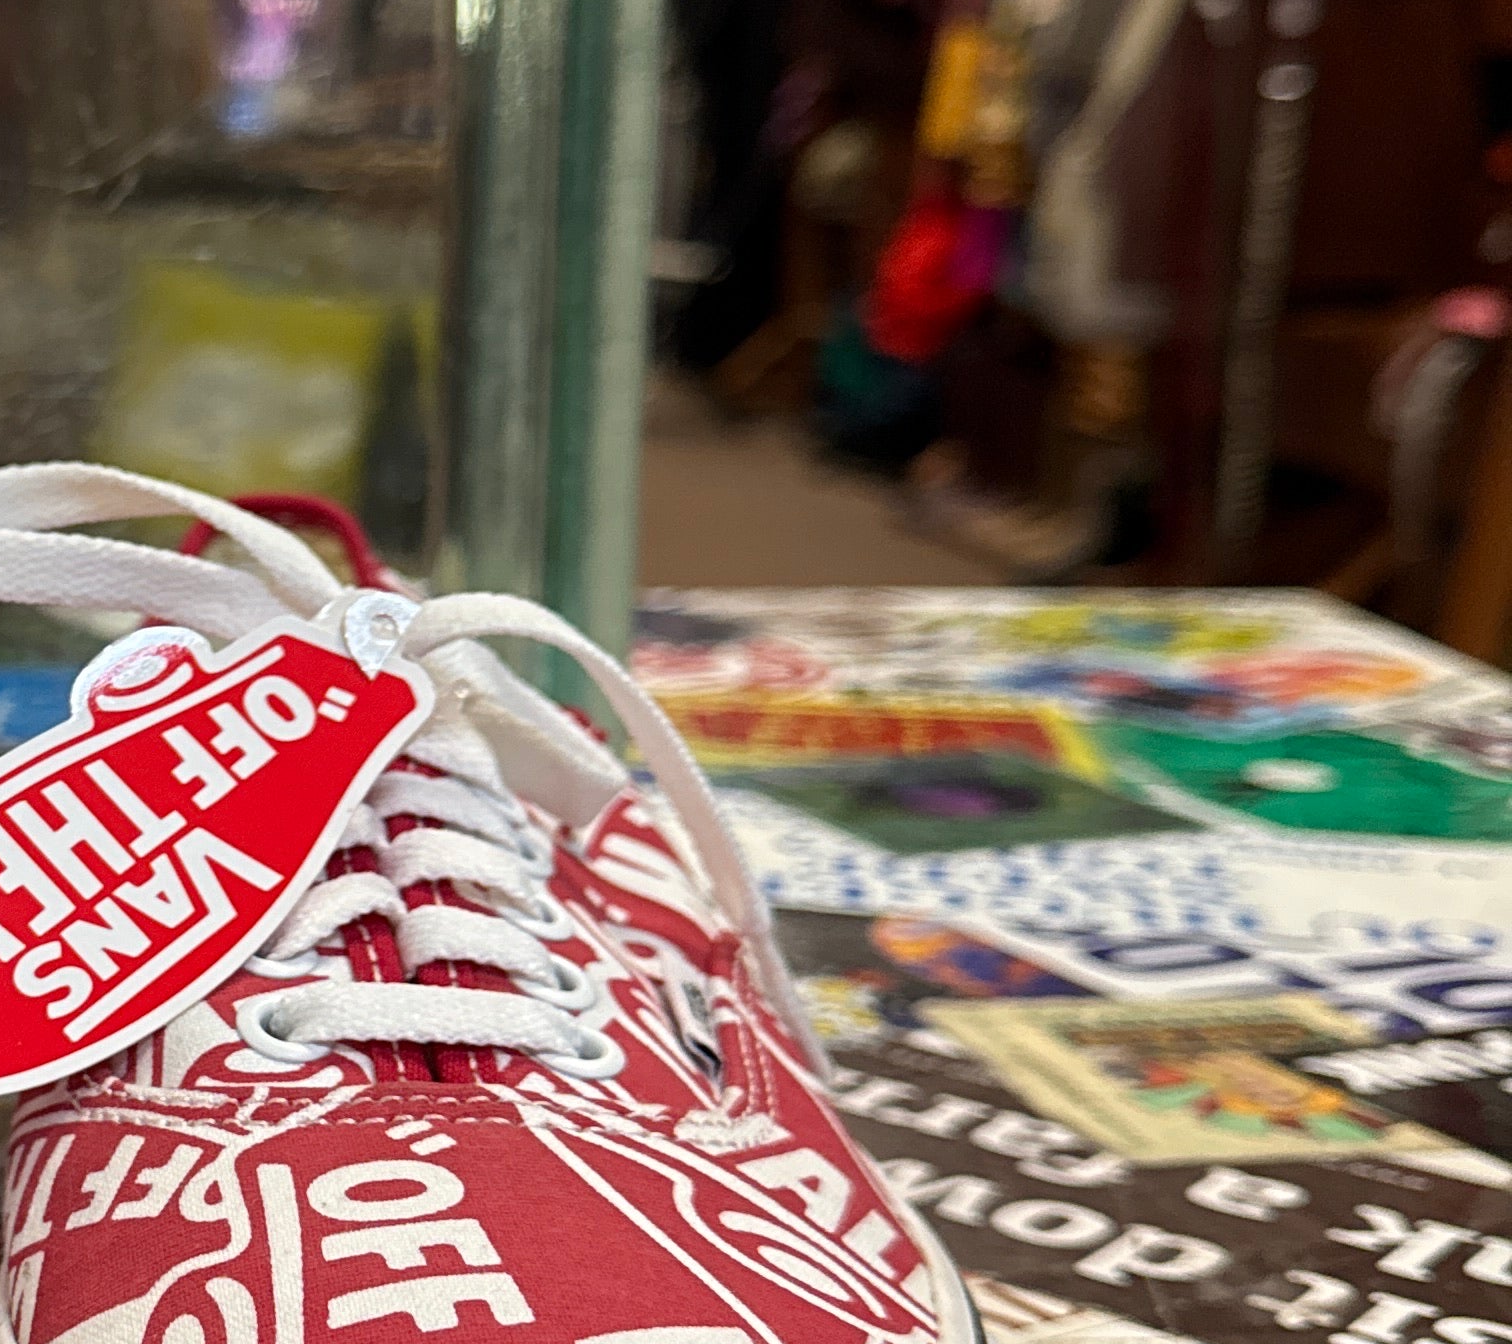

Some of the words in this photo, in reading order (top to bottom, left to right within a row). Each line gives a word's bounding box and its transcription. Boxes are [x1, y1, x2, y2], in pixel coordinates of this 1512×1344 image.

[159, 674, 355, 811] "OFF
[12, 828, 283, 1043] VANS
[305, 1114, 536, 1333] "OFF
[875, 1158, 1231, 1287] dow
[1186, 1165, 1308, 1222] a
